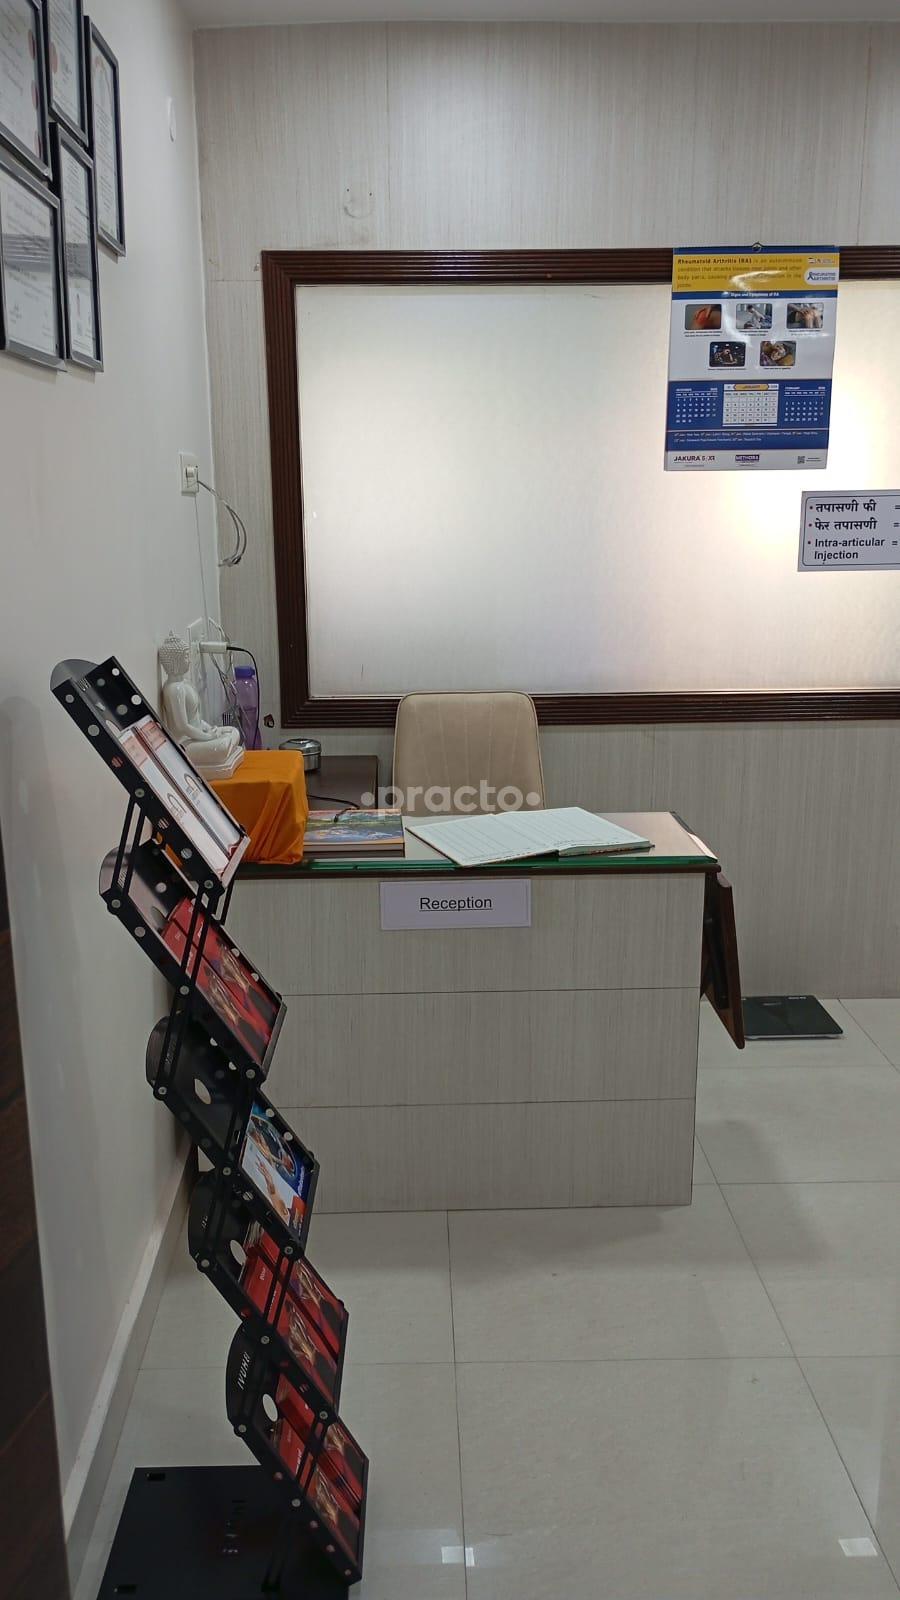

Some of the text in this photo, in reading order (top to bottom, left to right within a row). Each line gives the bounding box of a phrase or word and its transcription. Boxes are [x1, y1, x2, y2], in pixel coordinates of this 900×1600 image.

[816, 499, 859, 512] तपासणी
[863, 499, 877, 512] फी
[815, 518, 830, 531] फेर
[834, 517, 877, 530] तपासणी
[815, 537, 885, 547] Intra-articular
[814, 550, 859, 561] Injection
[420, 896, 493, 912] Reception
